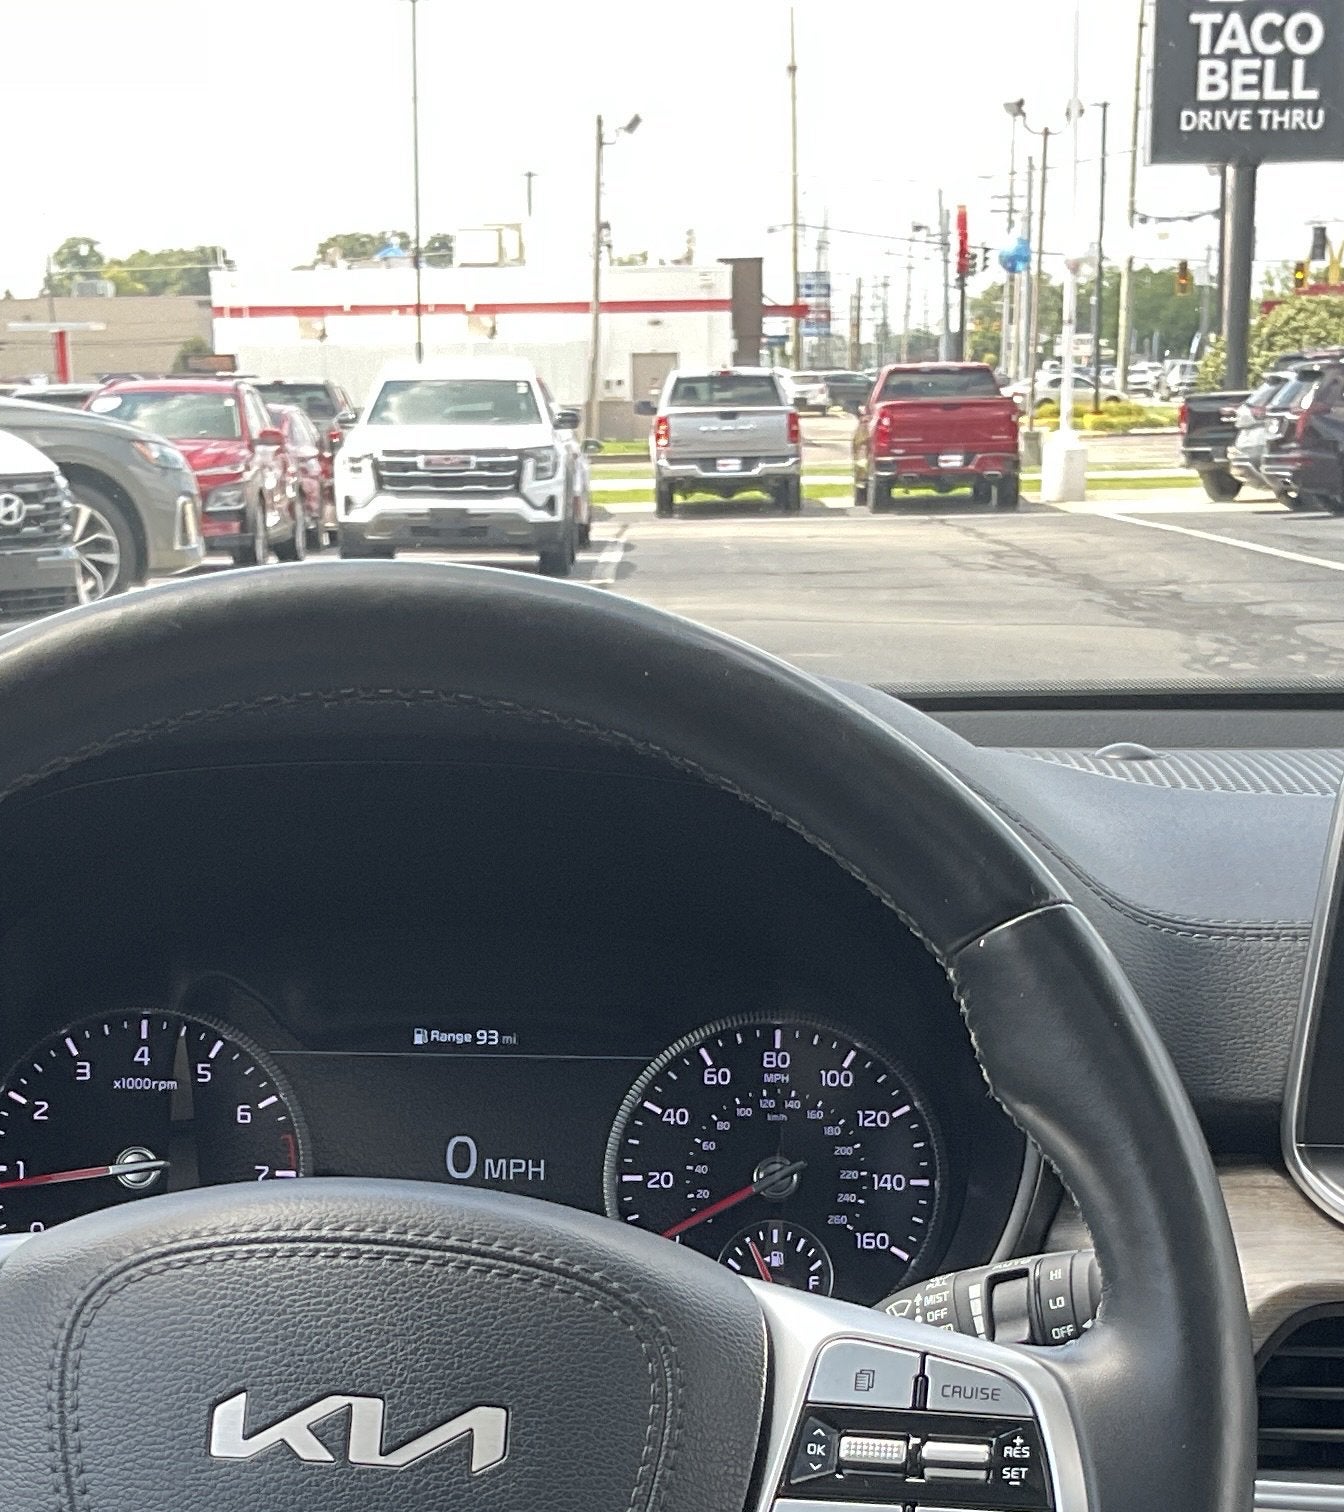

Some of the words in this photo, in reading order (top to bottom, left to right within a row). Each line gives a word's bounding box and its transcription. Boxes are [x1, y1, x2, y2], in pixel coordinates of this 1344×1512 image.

[1189, 12, 1325, 55] TACO
[1197, 58, 1320, 101] BELL
[1180, 109, 1252, 131] DRIVE
[1257, 108, 1325, 131] THRU
[430, 1030, 473, 1044] Range
[476, 1030, 499, 1045] 93
[502, 1033, 517, 1045] mi
[133, 1047, 151, 1066] 4
[762, 1052, 791, 1069] 80
[76, 1062, 91, 1080] 3
[197, 1064, 212, 1082] 5
[703, 1068, 731, 1085] 60
[763, 1073, 789, 1084] MPH
[820, 1070, 853, 1087] 100
[113, 1078, 178, 1091] x1000rpm
[33, 1101, 49, 1120] 2
[736, 1107, 753, 1117] 100
[784, 1100, 801, 1109] 140
[237, 1105, 251, 1124] 6
[662, 1108, 689, 1125] 40
[806, 1110, 824, 1119] 160
[857, 1110, 890, 1127] 120
[716, 1121, 731, 1131] 80
[824, 1126, 841, 1136] 180
[702, 1141, 716, 1151] 60
[834, 1146, 853, 1156] 200
[446, 1135, 478, 1179] 0
[484, 1159, 546, 1181] MPH
[15, 1161, 25, 1179] 1
[254, 1165, 270, 1182] 7
[694, 1165, 709, 1174] 40
[839, 1170, 859, 1179] 220
[647, 1171, 674, 1189] 20
[872, 1174, 905, 1191] 140
[696, 1189, 710, 1199] 20
[837, 1193, 856, 1203] 240
[827, 1215, 847, 1225] 260
[856, 1232, 889, 1250] 160
[1049, 1268, 1062, 1281] HI
[808, 1277, 820, 1290] F
[924, 1291, 950, 1307] MIST
[1049, 1297, 1065, 1310] LO
[926, 1308, 948, 1322] OFF
[1051, 1324, 1074, 1339] OFF
[940, 1384, 1002, 1402] CRUISE
[209, 1390, 508, 1475] KIA
[807, 1443, 826, 1456] OK
[1003, 1446, 1031, 1459] RES
[1002, 1467, 1029, 1480] SET
